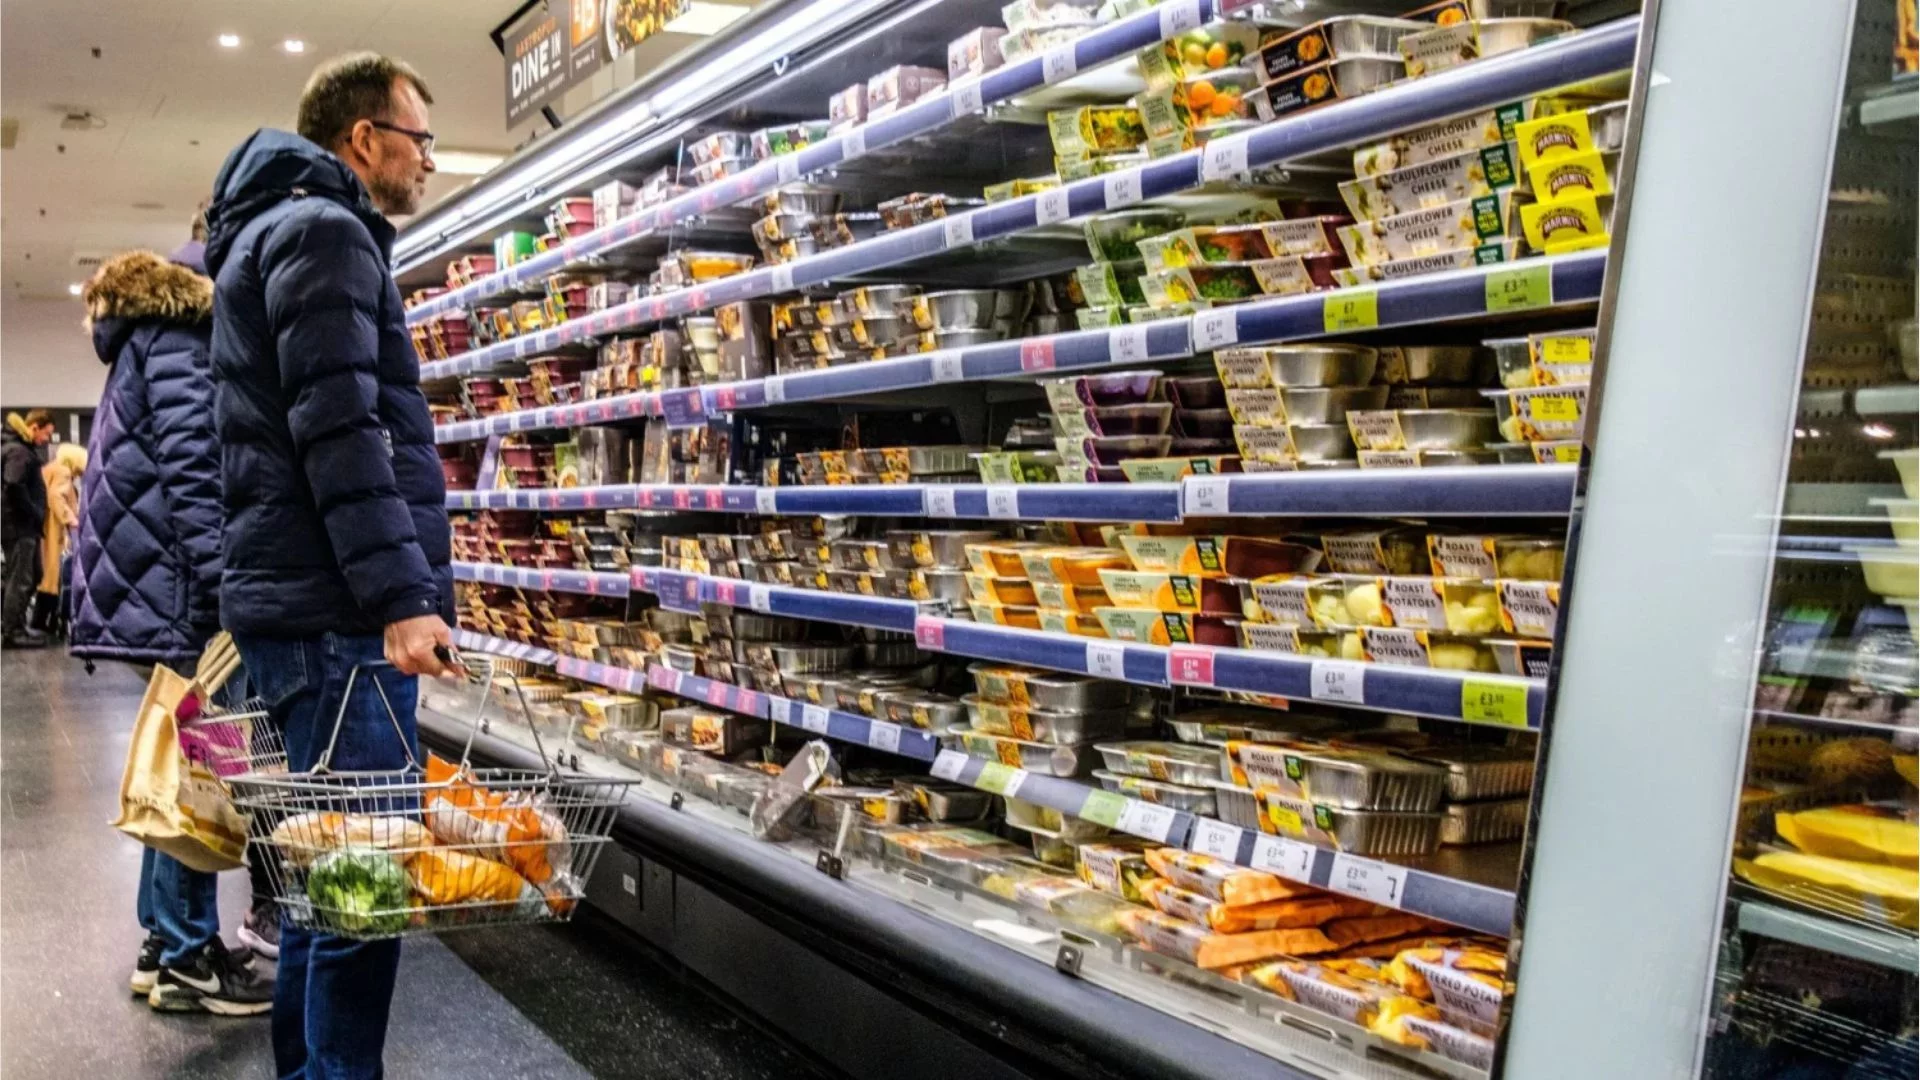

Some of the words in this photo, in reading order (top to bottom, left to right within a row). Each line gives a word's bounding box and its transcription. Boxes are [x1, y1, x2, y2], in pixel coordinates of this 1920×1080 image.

[512, 39, 549, 99] DINE
[551, 29, 561, 59] IN
[1408, 119, 1478, 145] CAULIFLOWER
[1538, 133, 1573, 148] MARMITE
[1428, 139, 1464, 156] CHEESE
[1391, 158, 1462, 184] CAULIFLOWER
[1411, 178, 1449, 195] CHEESE
[1552, 173, 1588, 189] MARMITE
[1386, 207, 1453, 231] CAULIFLOWER
[1543, 215, 1581, 233] MARMITE
[1268, 221, 1316, 233] CAULIFLOWER
[1404, 226, 1440, 242] CHEESE
[1384, 255, 1455, 276] CAULIFLOWER
[1344, 301, 1355, 314] £7
[1364, 456, 1414, 465] CAULIFLOWER
[1326, 540, 1375, 549] PARMENTIER
[1445, 541, 1475, 552] ROAST
[1334, 552, 1375, 561] POTATOES
[1440, 554, 1487, 566] POTATOES
[1256, 587, 1305, 598] PARMENTIER
[1395, 584, 1425, 594] ROAST
[1513, 588, 1540, 599] ROAST
[1264, 600, 1305, 611] POTATOES
[1388, 597, 1437, 608] POTATOES
[1507, 601, 1552, 616] POTATOES
[1247, 627, 1294, 637] PARMENTIER
[1376, 633, 1408, 643] ROAST
[1255, 641, 1292, 650] POTATOES
[1370, 646, 1420, 658] POTATOES
[1251, 751, 1275, 762] ROAST
[1246, 763, 1284, 778] POTATOES
[1279, 800, 1303, 811] ROAST
